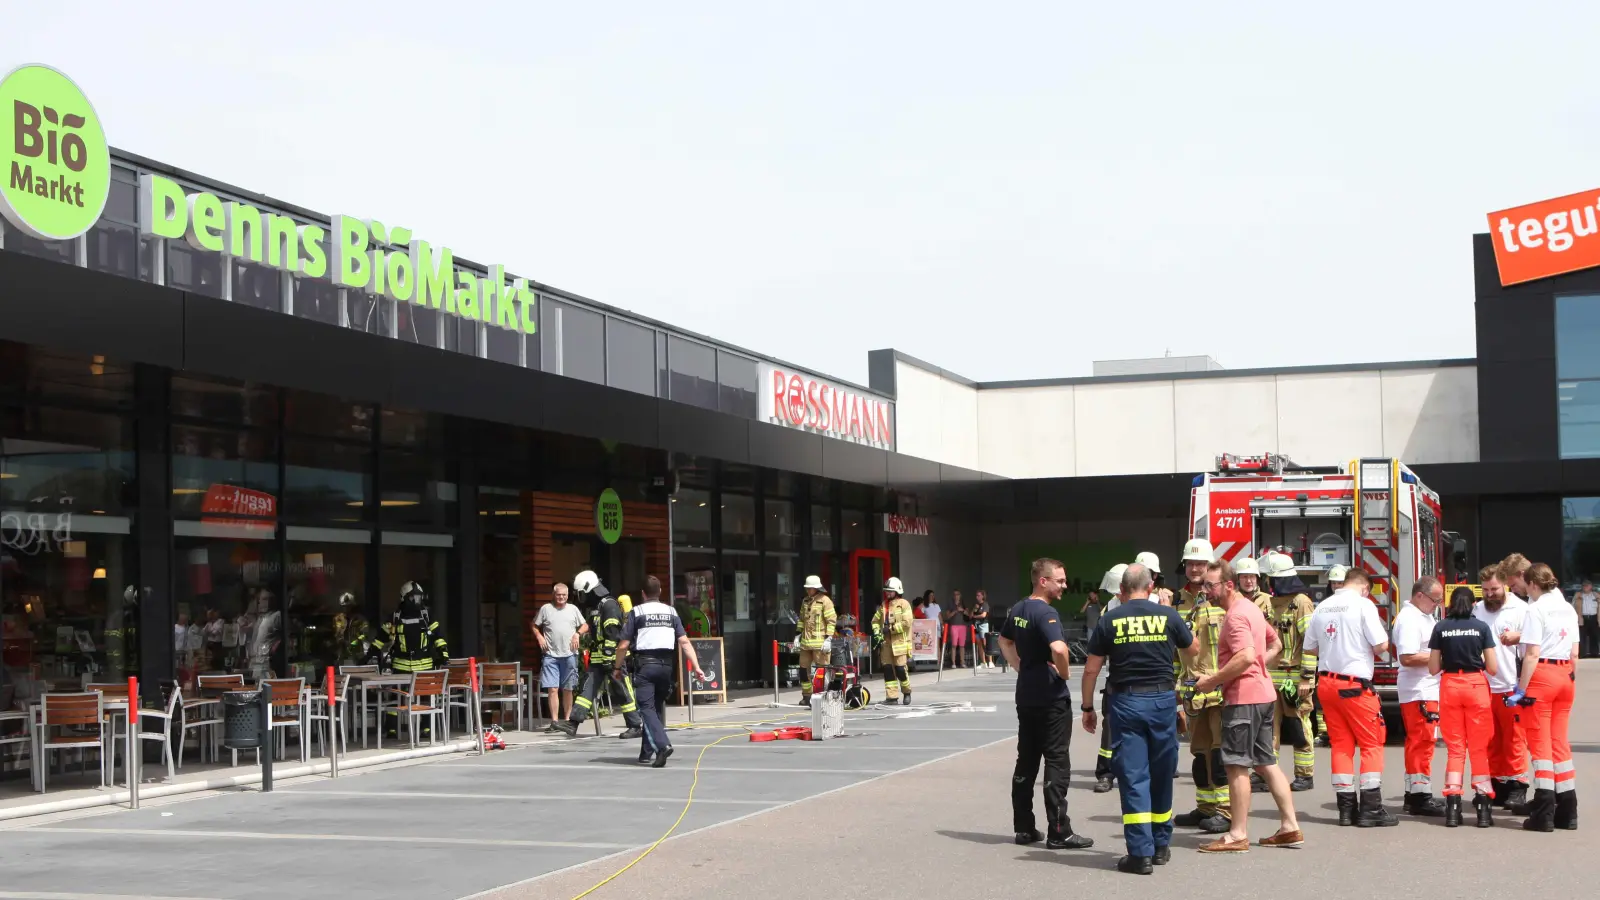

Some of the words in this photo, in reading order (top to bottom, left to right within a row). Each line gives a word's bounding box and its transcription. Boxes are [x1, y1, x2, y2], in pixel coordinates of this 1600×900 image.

[10, 161, 85, 208] Markt
[150, 175, 327, 278] Denns
[1498, 196, 1600, 253] tegu
[774, 370, 890, 445] ROSSMANN
[1215, 507, 1246, 515] Ansbach
[888, 512, 929, 535] ROSSMANN
[1216, 516, 1244, 529] 47/1
[1112, 615, 1168, 637] THW
[1441, 628, 1480, 638] Notärztin
[1113, 636, 1128, 645] GST
[1128, 633, 1168, 643] NÜRNBERG
